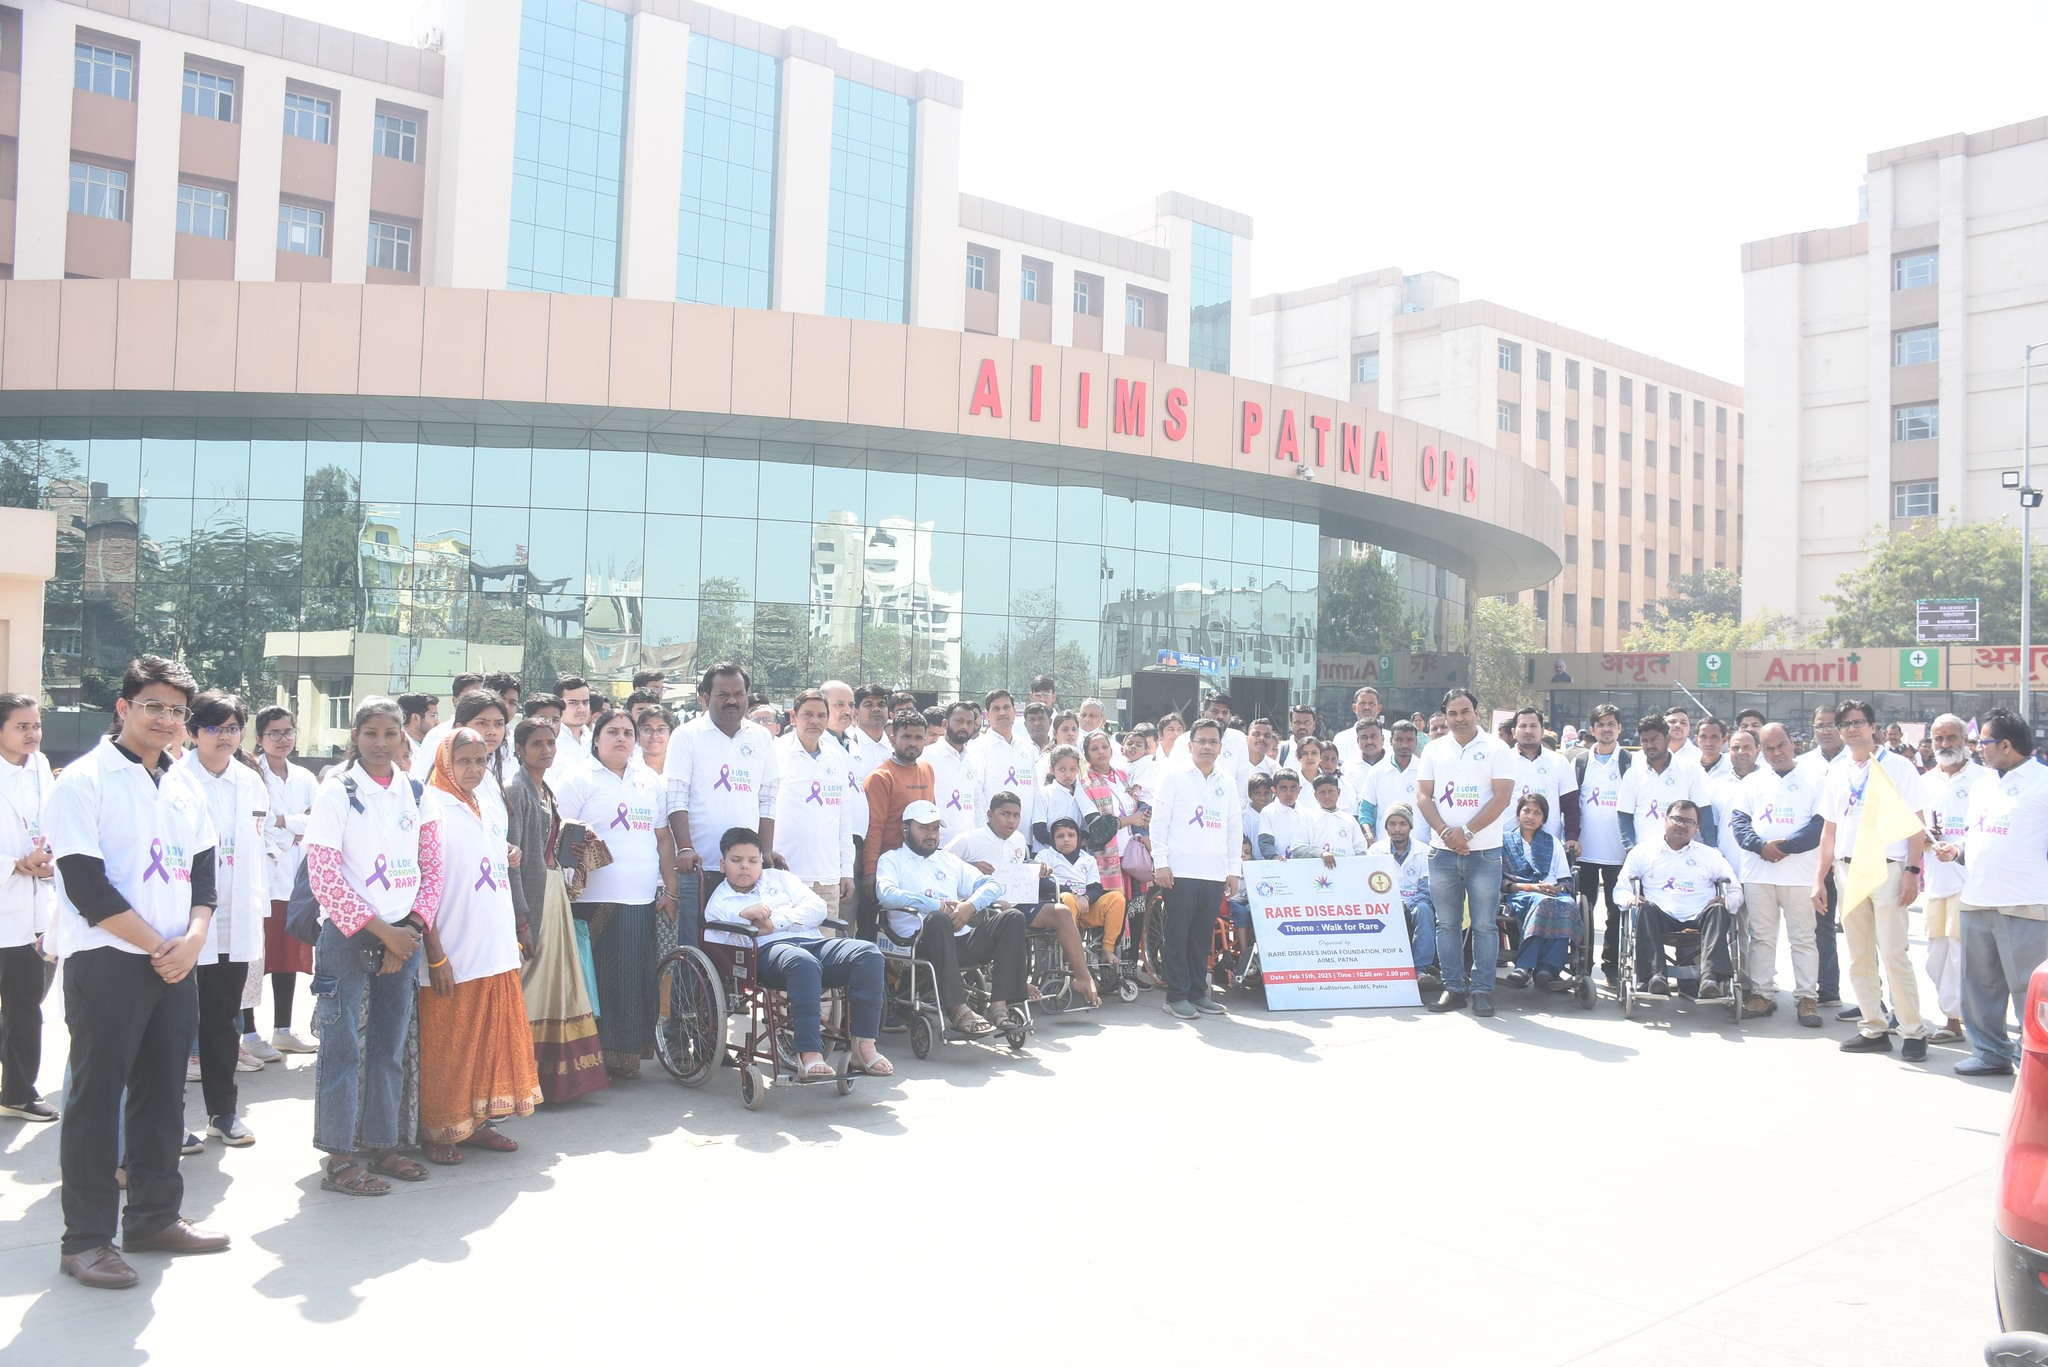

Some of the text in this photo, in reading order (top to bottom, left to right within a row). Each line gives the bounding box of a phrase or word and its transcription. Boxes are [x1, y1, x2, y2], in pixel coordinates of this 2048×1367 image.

[970, 358, 1479, 503] AIIMS PATNA OPD
[1601, 653, 1671, 682] अमृत
[1764, 652, 1862, 682] Amrit
[1457, 799, 1479, 807] RARE
[1601, 800, 1617, 808] RARE
[633, 821, 651, 831] RARE
[1206, 821, 1222, 830] RARE
[1944, 828, 1965, 836] RARE
[1986, 826, 2008, 836] RARE
[398, 859, 411, 869] LOE
[1265, 902, 1391, 919] RARE DISEASE DAY
[1284, 924, 1315, 933] Theme
[1321, 923, 1343, 931] Walk
[1344, 923, 1357, 931] for
[1359, 922, 1379, 931] Rare
